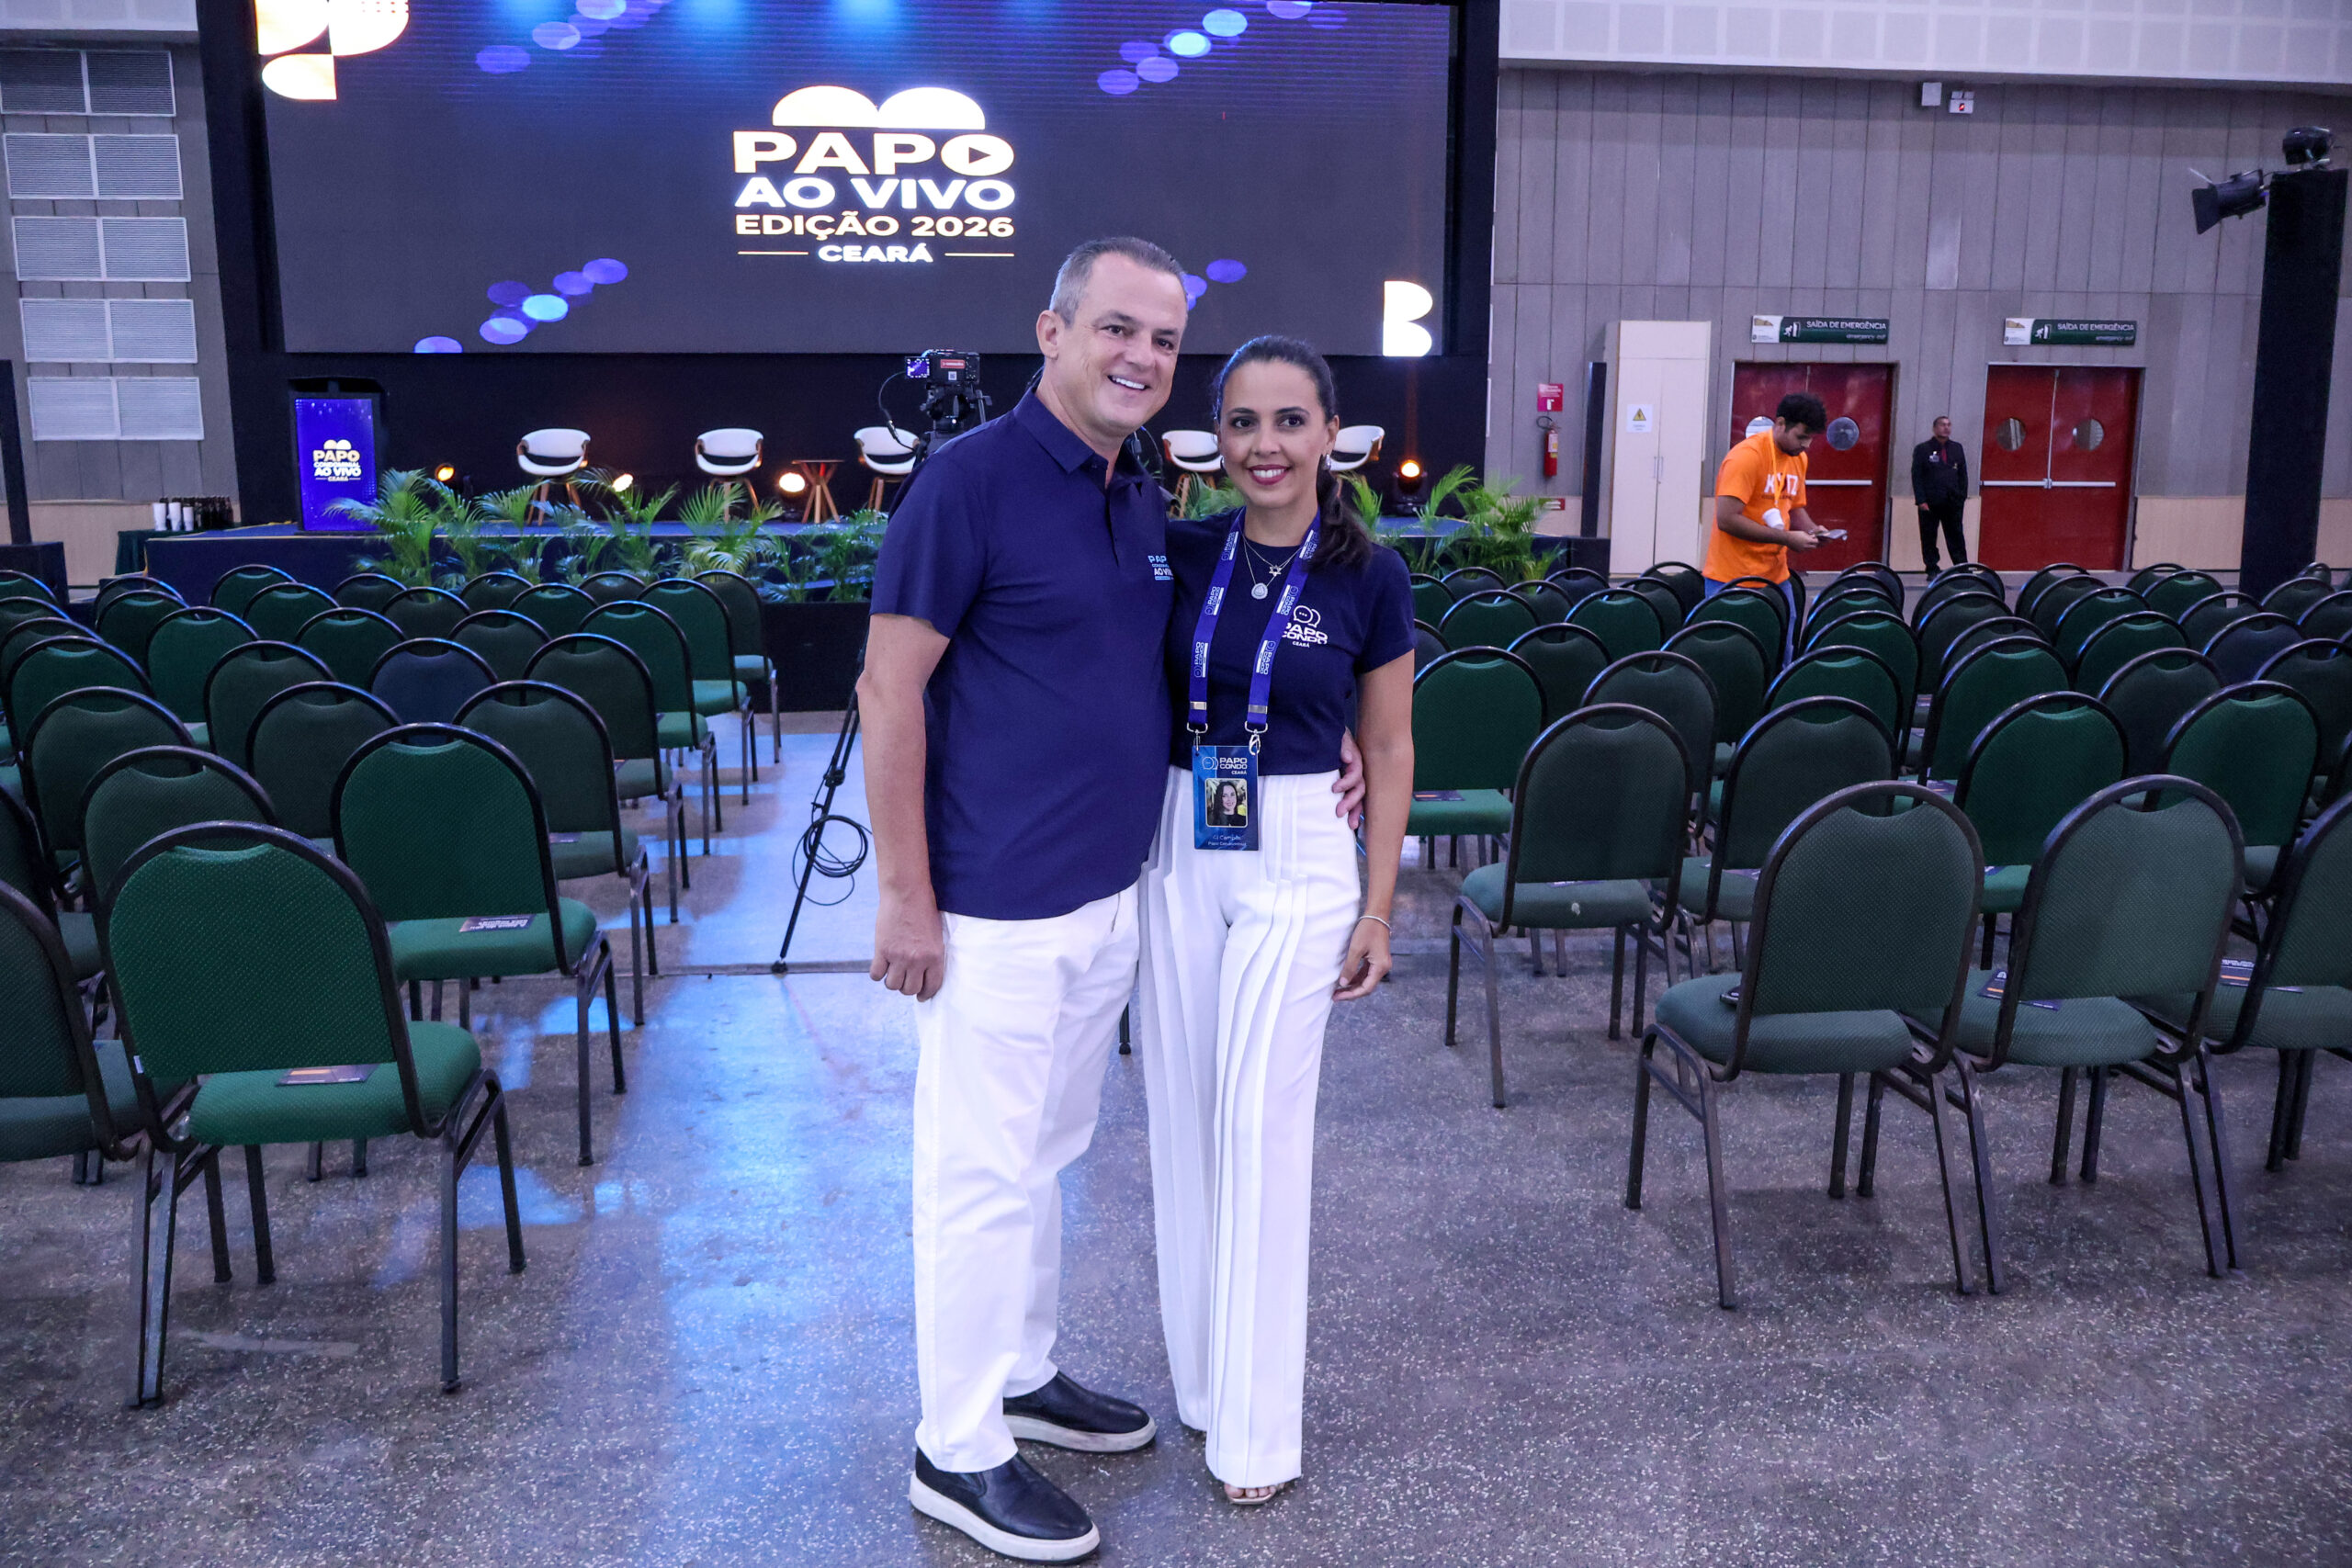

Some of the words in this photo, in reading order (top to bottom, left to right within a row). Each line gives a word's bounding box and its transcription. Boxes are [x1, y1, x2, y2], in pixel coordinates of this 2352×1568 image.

[733, 130, 1014, 176] PAPO
[734, 177, 835, 209] AO
[850, 178, 1015, 210] VIVO
[735, 210, 899, 241] EDIÇÃO
[911, 216, 1014, 238] 2026
[818, 243, 933, 263] CEARÁ
[1806, 320, 1828, 329] SAÍDA
[1828, 321, 1839, 329] DE
[1840, 321, 1887, 330] EMERGÊNCIA
[2057, 322, 2079, 331] SAÍDA
[2089, 322, 2134, 332] EMERGÊNCIA
[313, 449, 360, 462] PAPO
[314, 467, 333, 477] AO
[333, 467, 362, 477] VIVO
